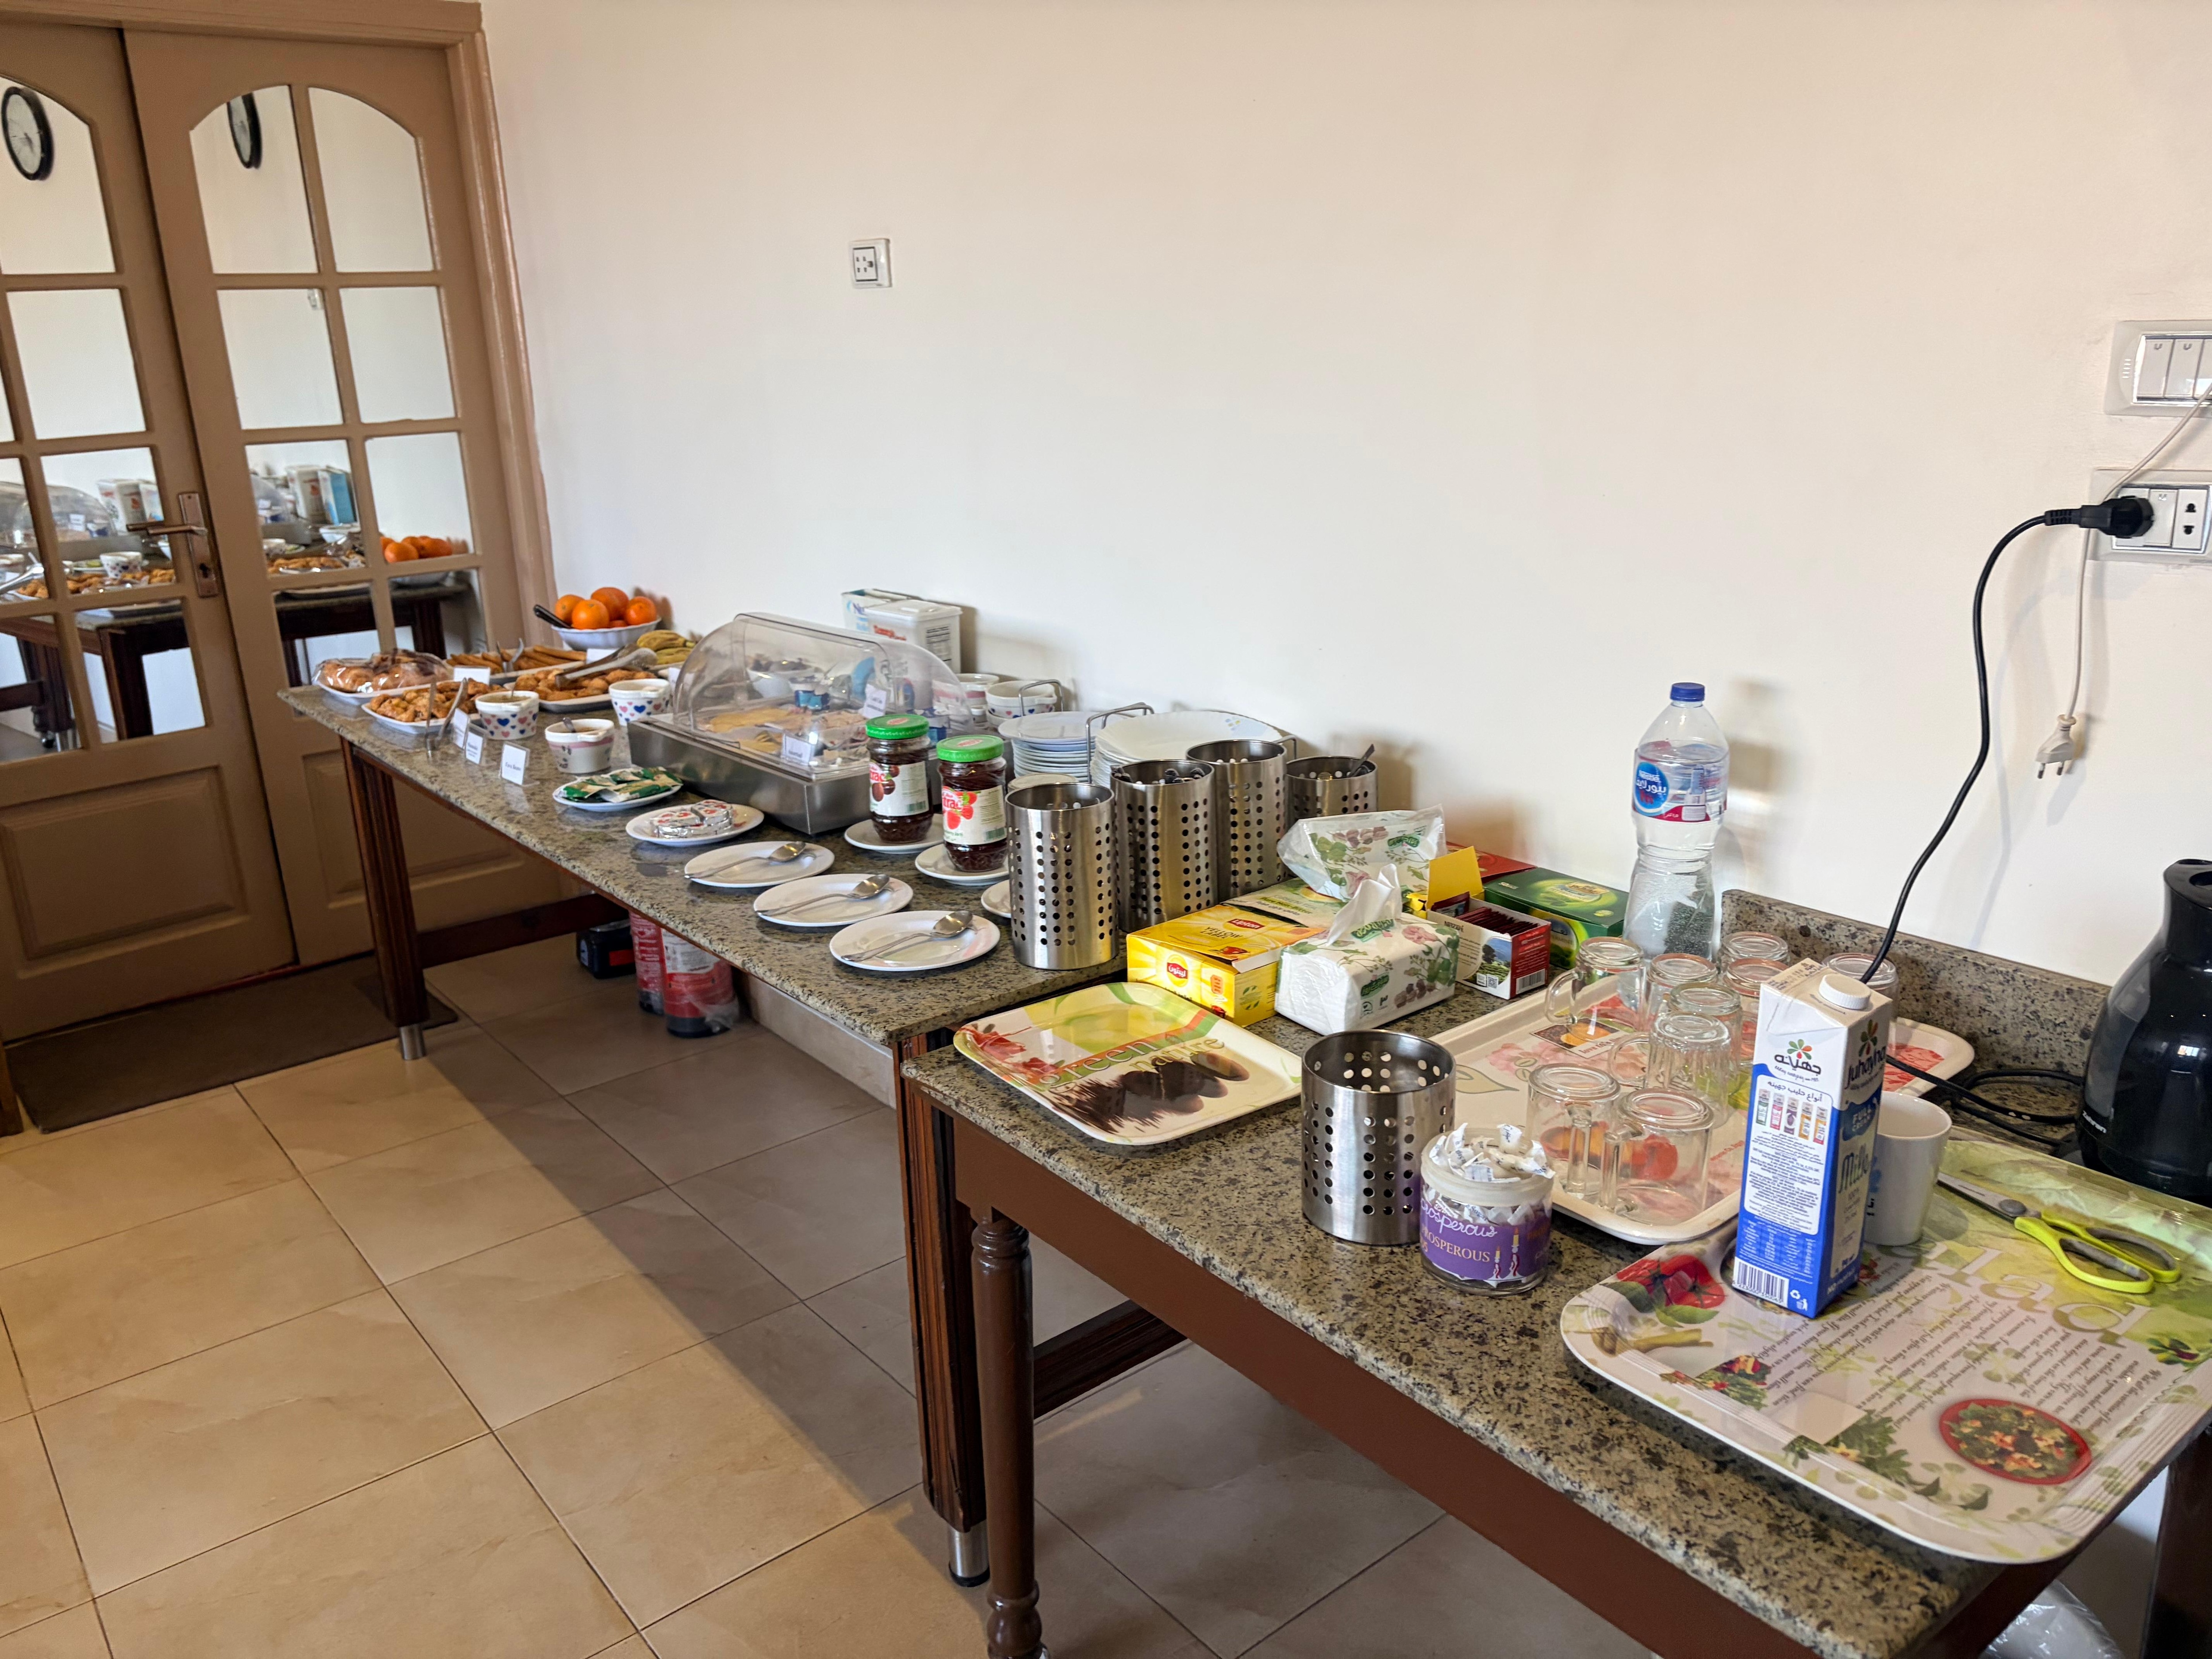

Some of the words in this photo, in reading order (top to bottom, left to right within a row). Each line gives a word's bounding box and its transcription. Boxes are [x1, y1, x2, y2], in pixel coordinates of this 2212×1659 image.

[870, 771, 885, 782] trac
[1233, 919, 1260, 929] Lipton
[1204, 926, 1244, 938] YELLOW
